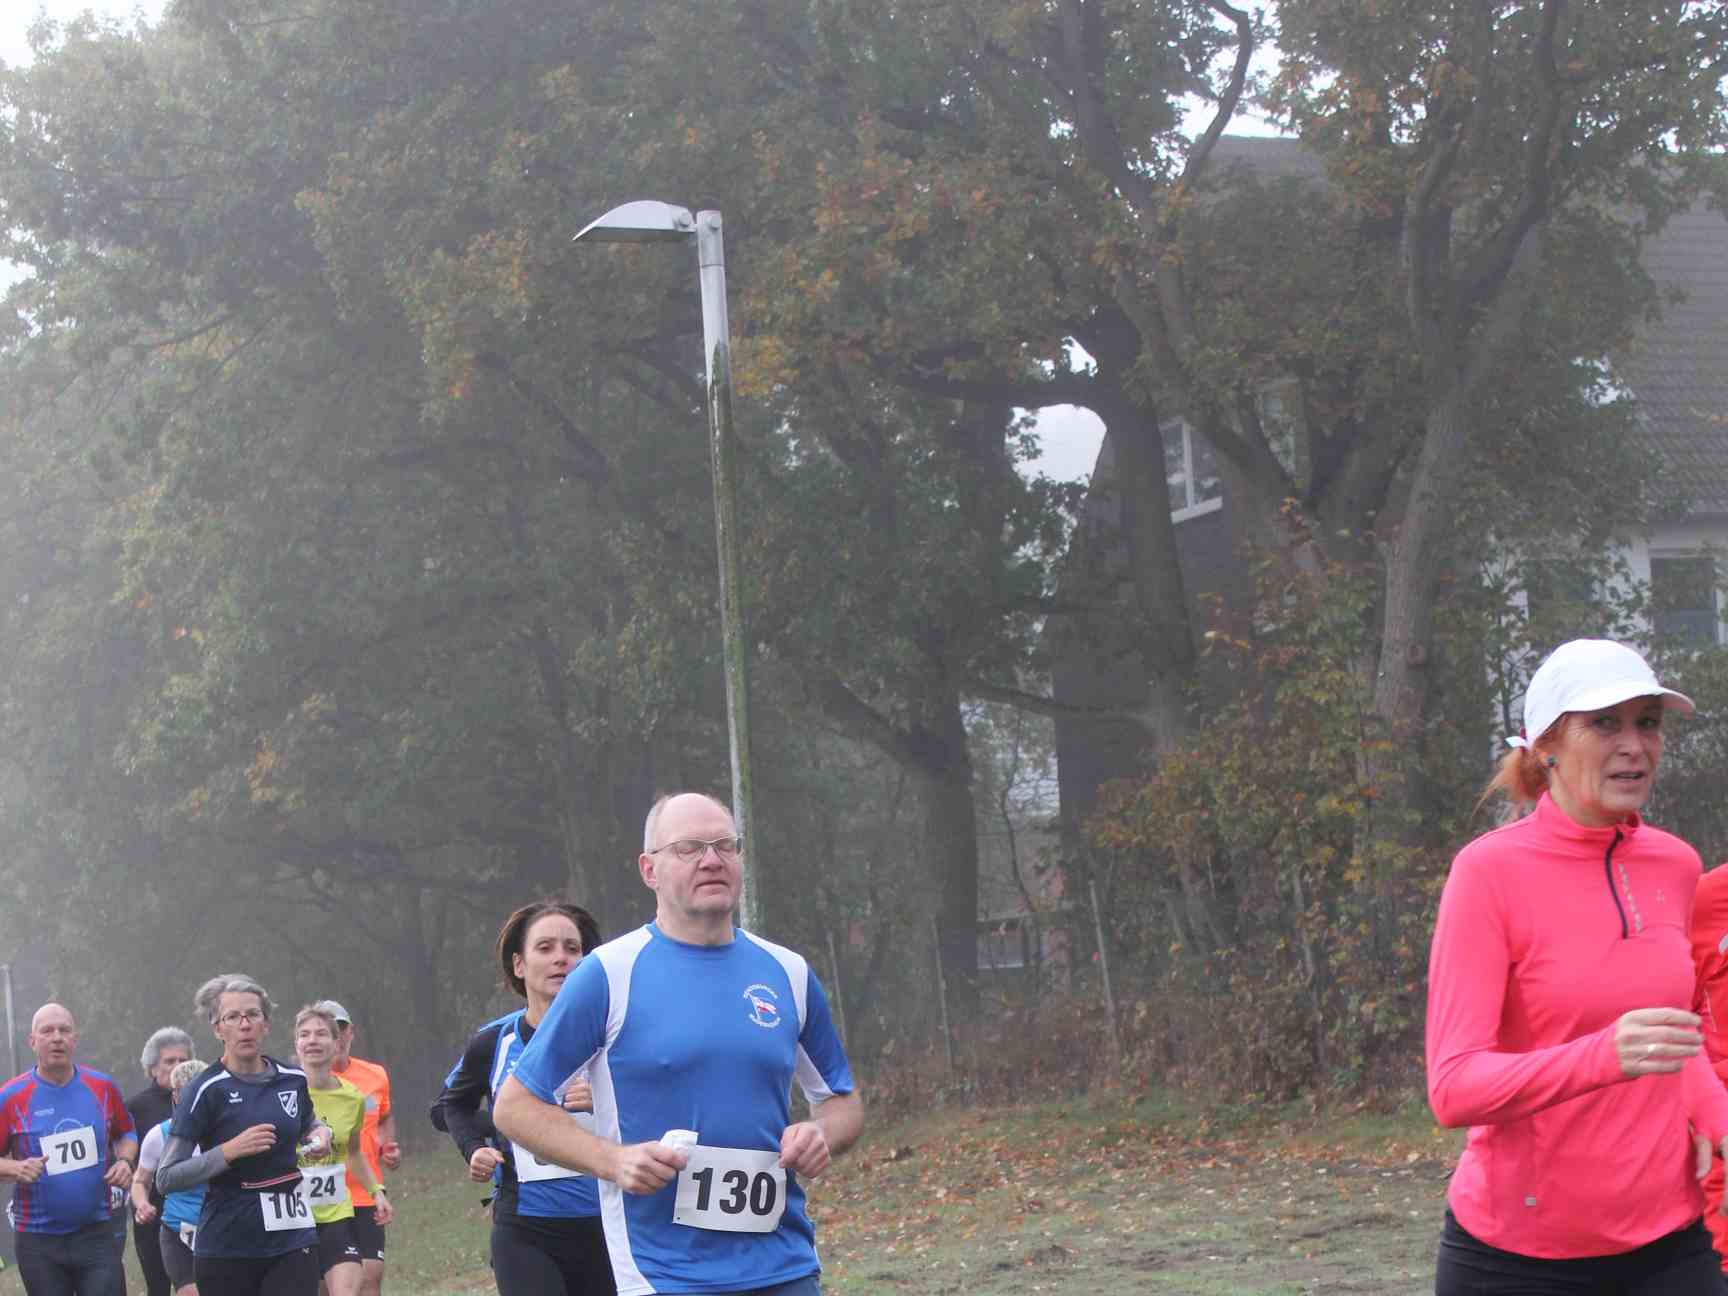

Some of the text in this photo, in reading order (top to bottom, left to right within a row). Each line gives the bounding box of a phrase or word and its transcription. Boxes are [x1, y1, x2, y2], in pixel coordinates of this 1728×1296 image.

[55, 1139, 87, 1164] 70
[310, 1176, 337, 1198] 24
[692, 1167, 777, 1216] 130
[268, 1191, 308, 1219] 105
